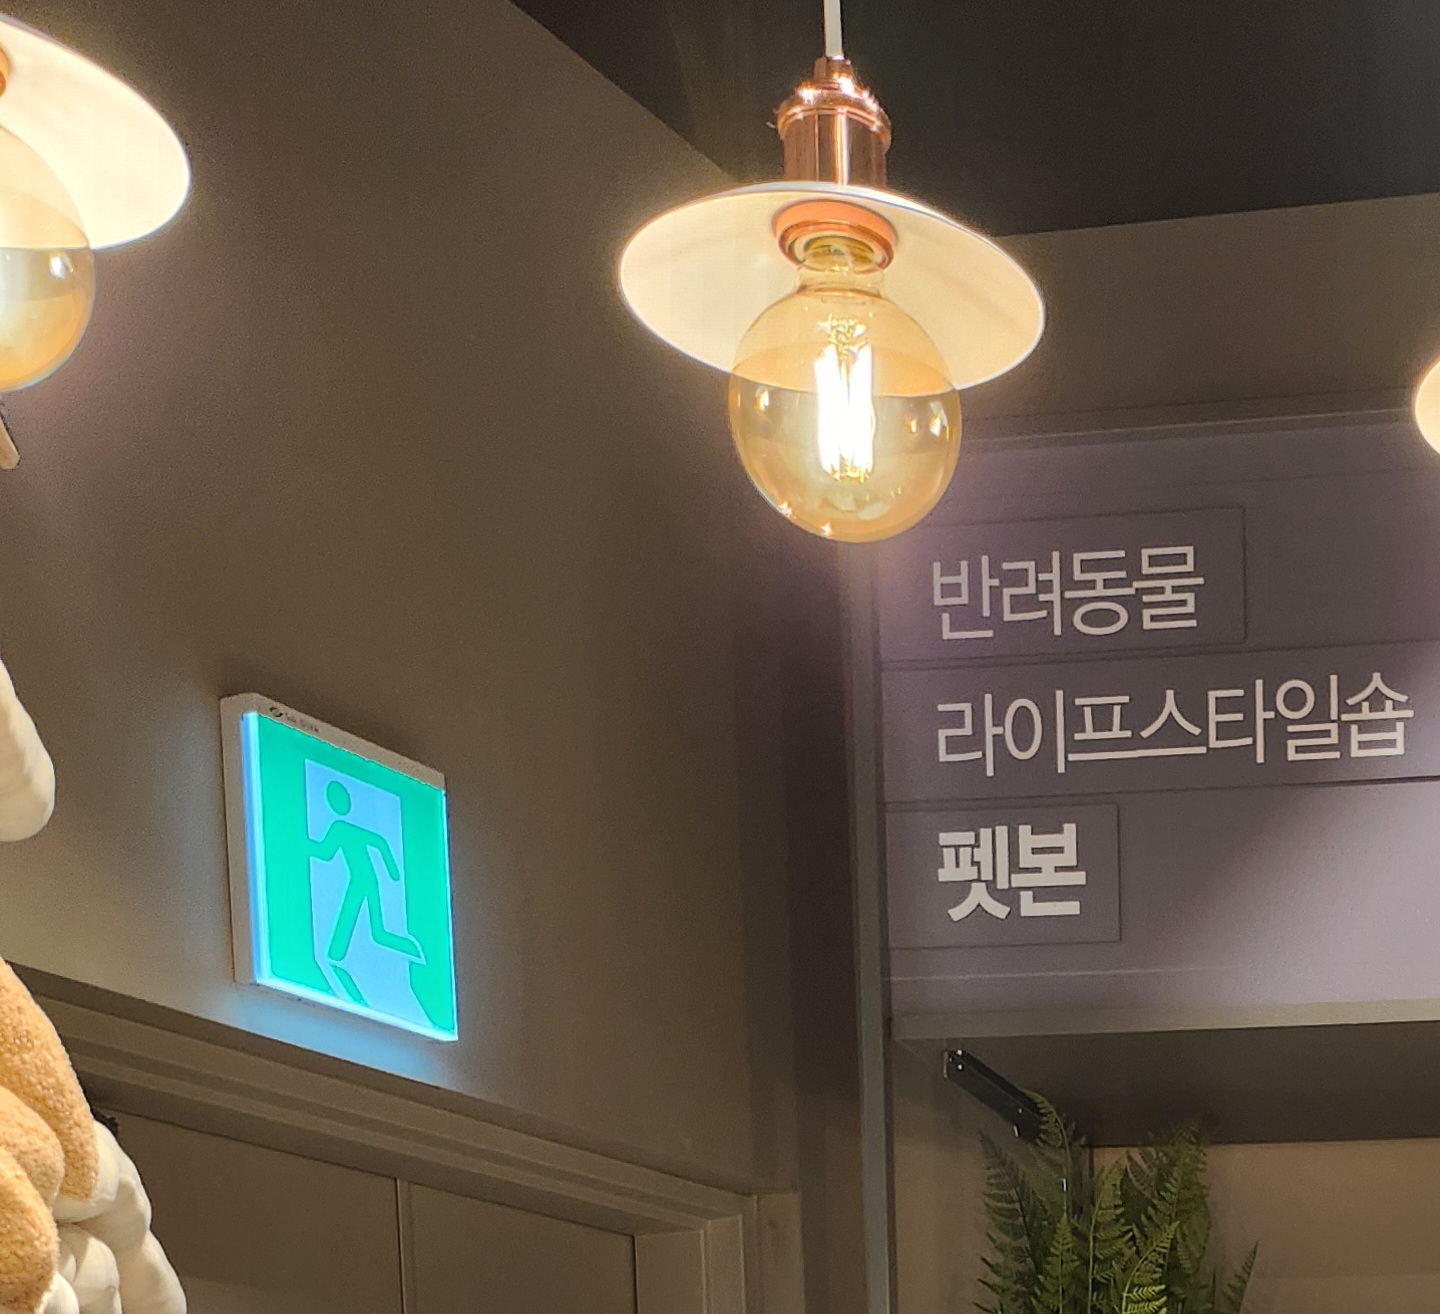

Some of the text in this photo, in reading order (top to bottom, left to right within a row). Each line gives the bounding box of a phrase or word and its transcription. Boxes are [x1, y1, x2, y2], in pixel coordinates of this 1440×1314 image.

[932, 545, 1205, 640] 반려동물
[937, 672, 1414, 776] 라이프스타일숍
[937, 823, 1087, 922] 펫본
